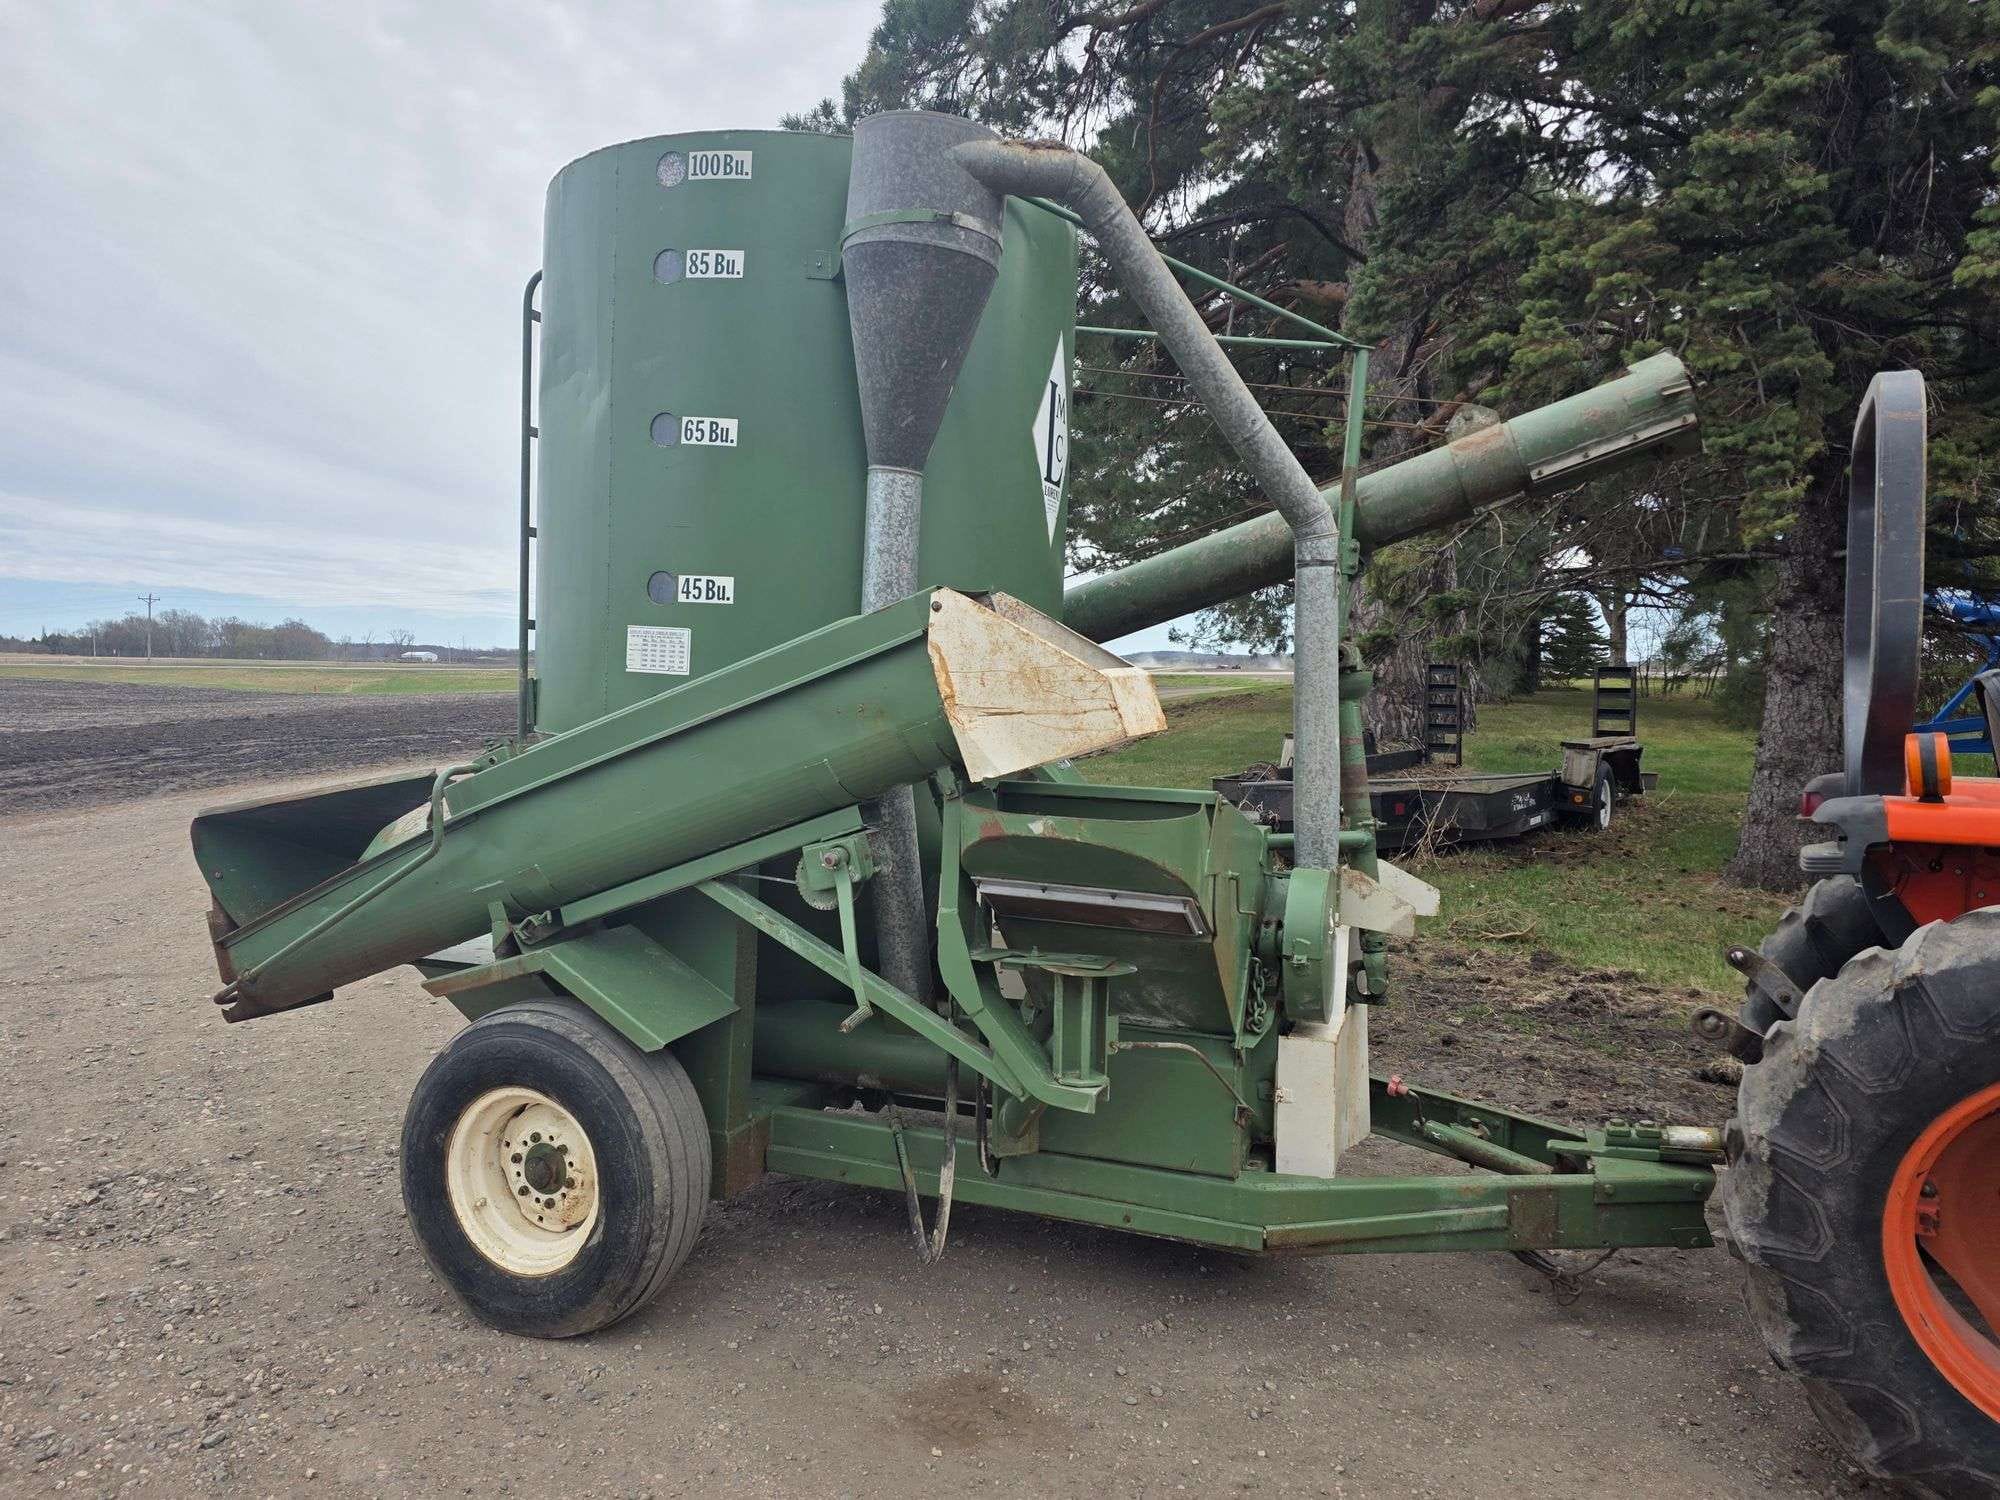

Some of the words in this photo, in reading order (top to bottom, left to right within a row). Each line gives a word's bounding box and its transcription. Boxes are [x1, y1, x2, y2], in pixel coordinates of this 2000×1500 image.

[691, 154, 720, 176] 100
[723, 154, 749, 176] Bu.
[688, 252, 710, 275] 85
[714, 253, 741, 276] Bu.
[684, 419, 705, 442] 65
[709, 420, 735, 444] Bu.
[681, 577, 702, 600] 45
[705, 579, 731, 602] Bu.
